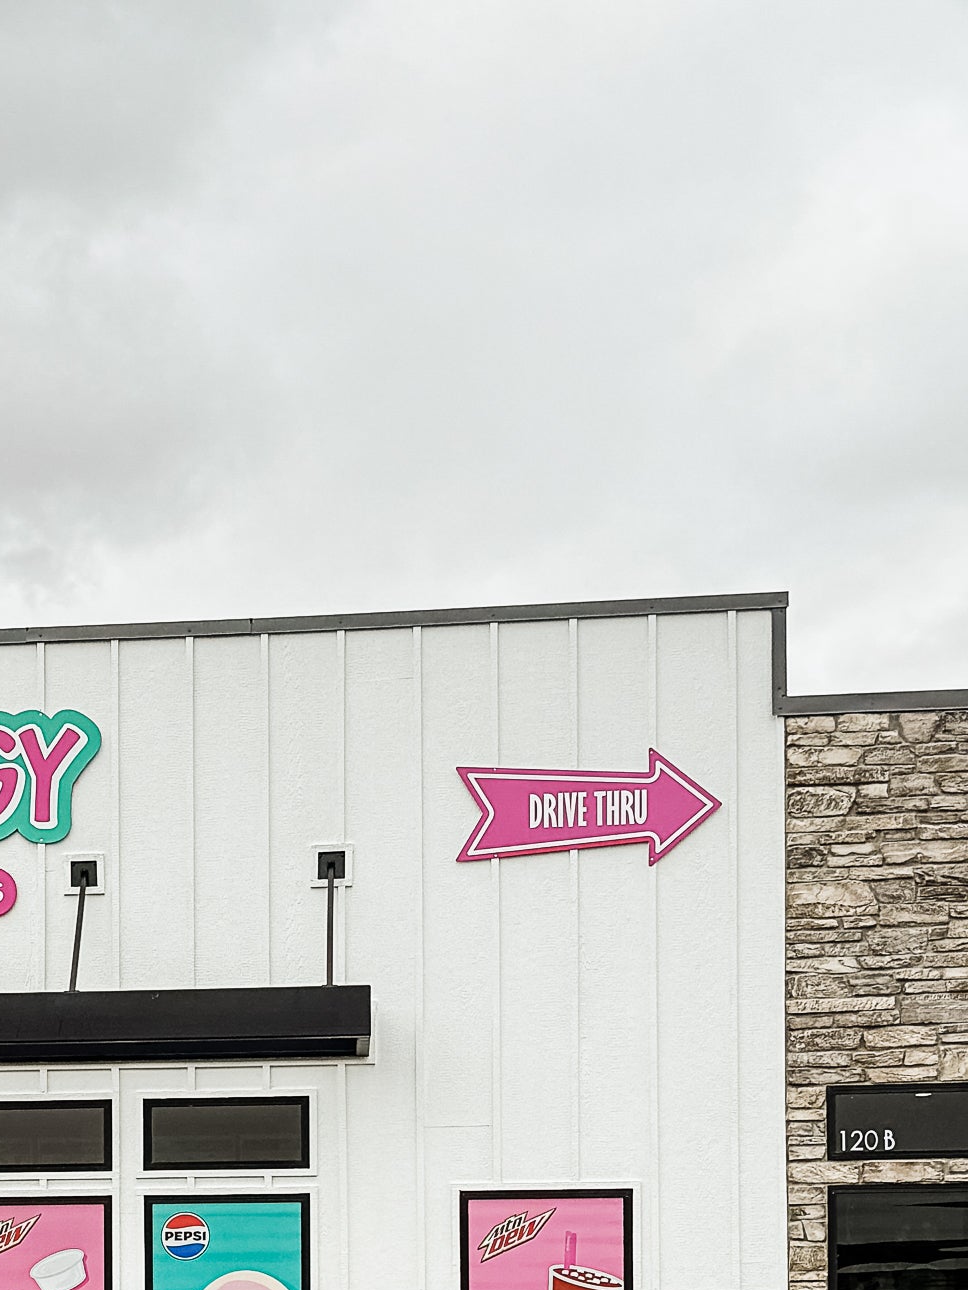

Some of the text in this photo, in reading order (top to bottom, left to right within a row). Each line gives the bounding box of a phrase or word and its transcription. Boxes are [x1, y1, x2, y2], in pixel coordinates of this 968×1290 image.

[529, 789, 648, 829] DRIVE THRU
[164, 1231, 207, 1241] PEPSI
